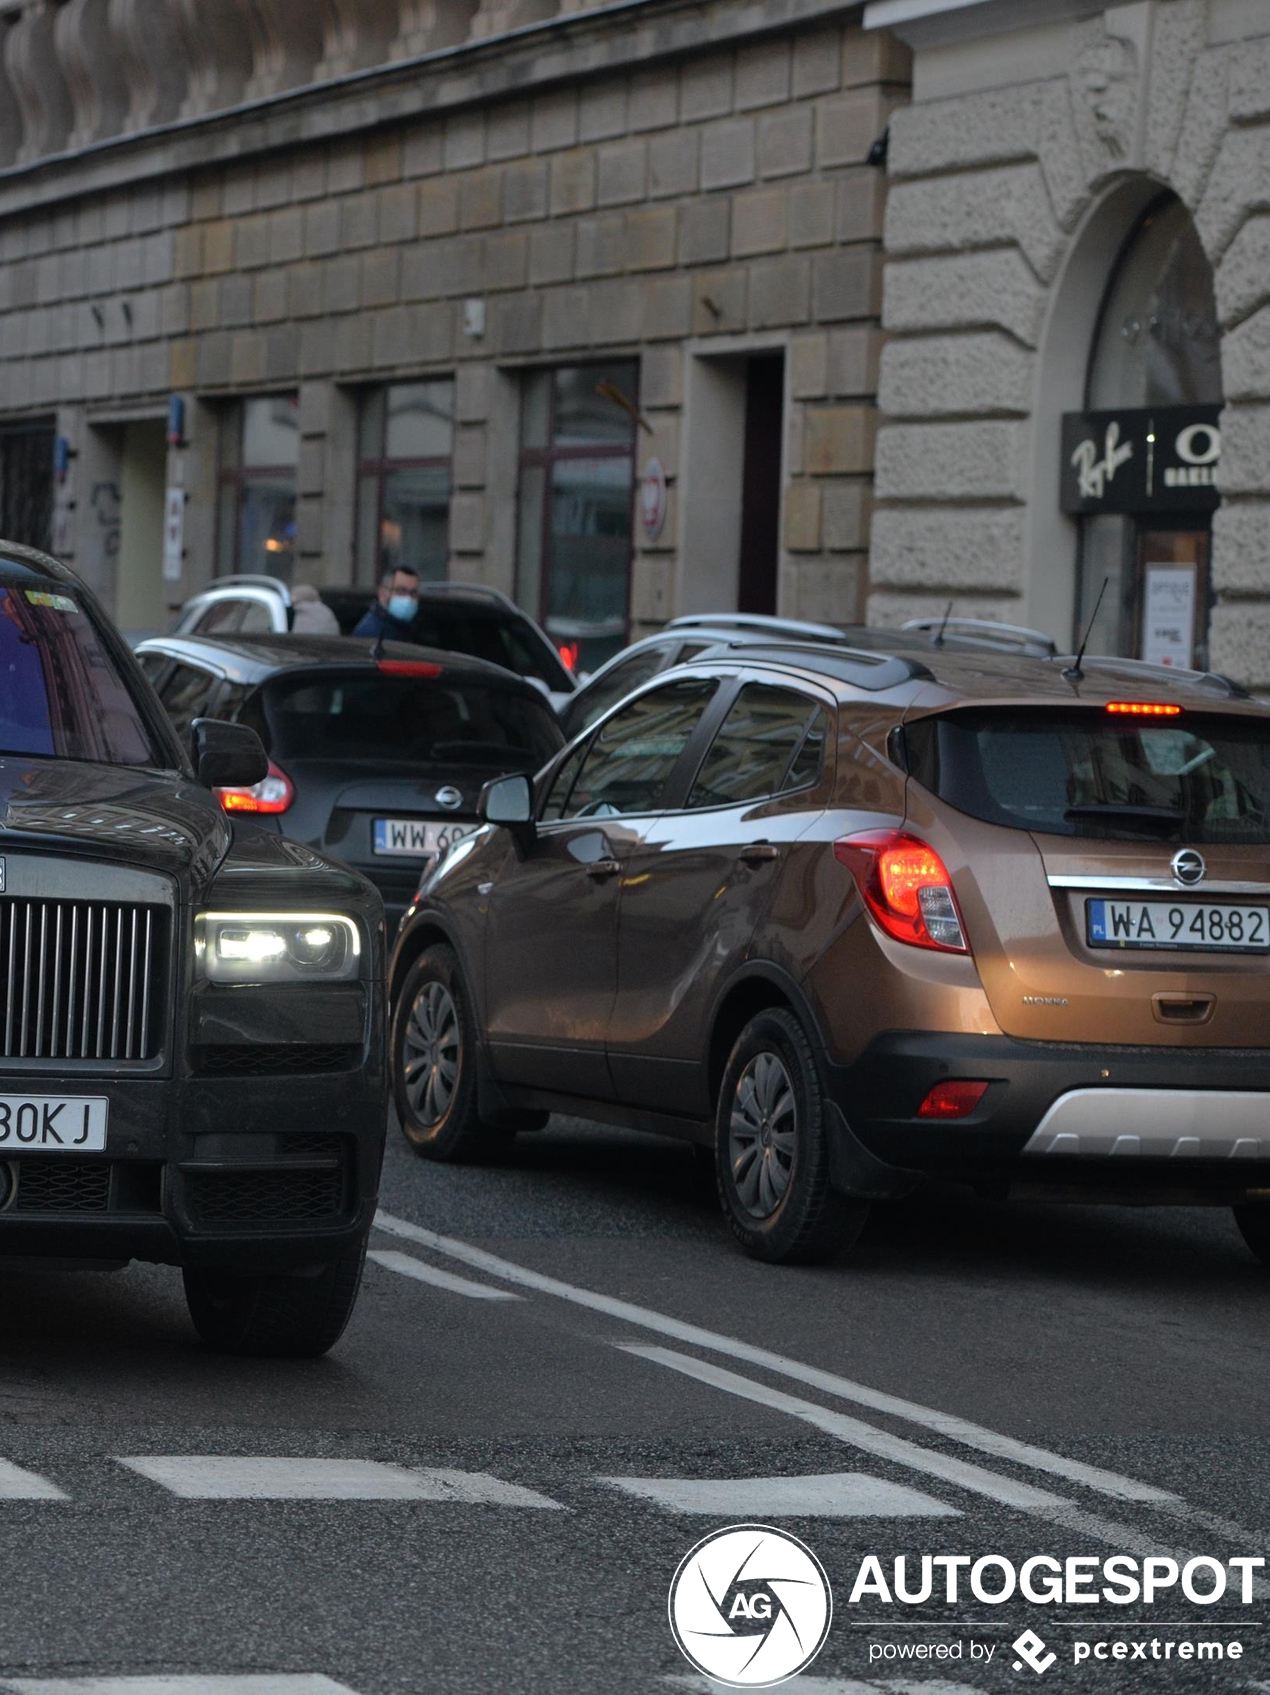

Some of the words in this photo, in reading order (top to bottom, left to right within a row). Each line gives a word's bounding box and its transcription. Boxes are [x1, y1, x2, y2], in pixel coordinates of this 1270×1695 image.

[392, 823, 426, 848] WW
[1093, 924, 1105, 935] PL
[1111, 905, 1156, 938] WA
[1168, 908, 1265, 943] 94882
